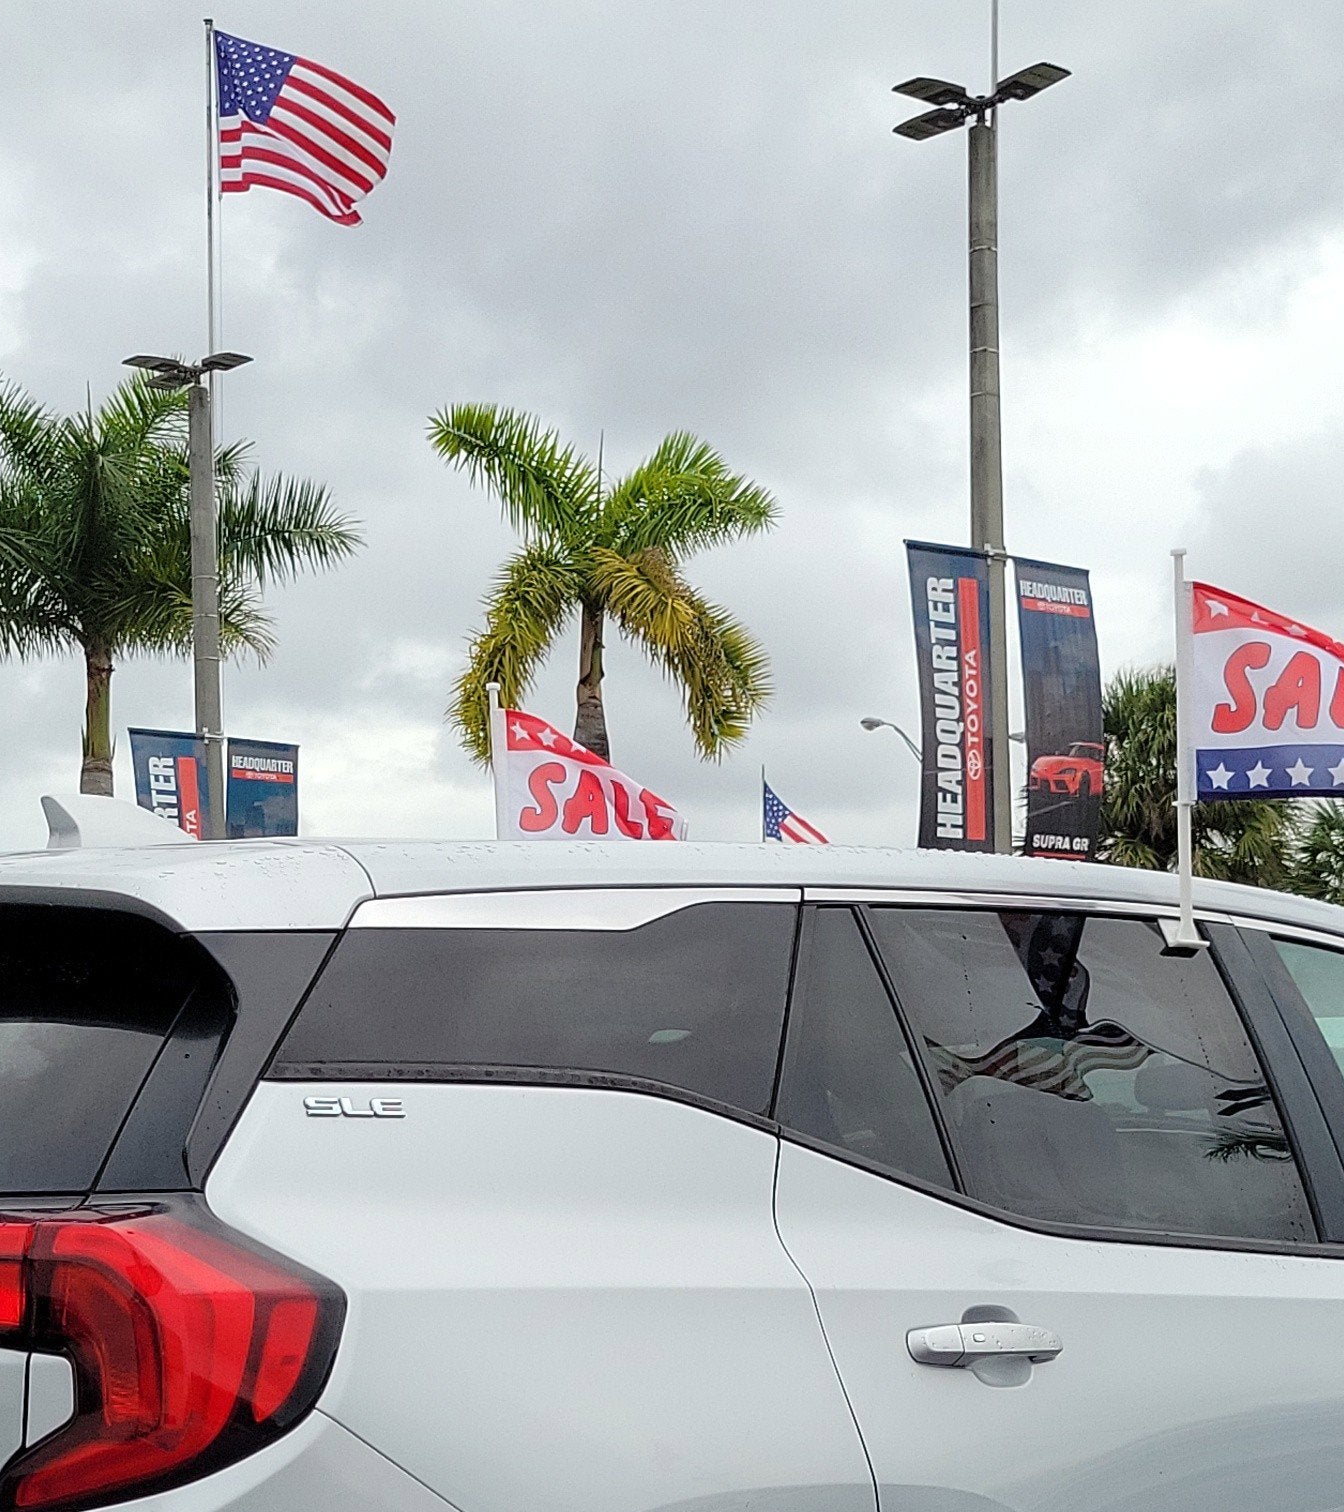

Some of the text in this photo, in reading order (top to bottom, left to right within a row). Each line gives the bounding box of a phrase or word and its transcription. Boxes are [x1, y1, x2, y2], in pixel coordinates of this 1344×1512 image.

[1019, 579, 1088, 606] HEADQUARTER
[926, 576, 965, 840] HEADQUARTER
[965, 649, 980, 746] TOYOTA
[231, 755, 294, 774] HEADQUARTER
[519, 762, 678, 841] SALE
[185, 809, 199, 838] TA
[1032, 833, 1090, 852] SUPRA GR
[303, 1096, 407, 1119] SLE
